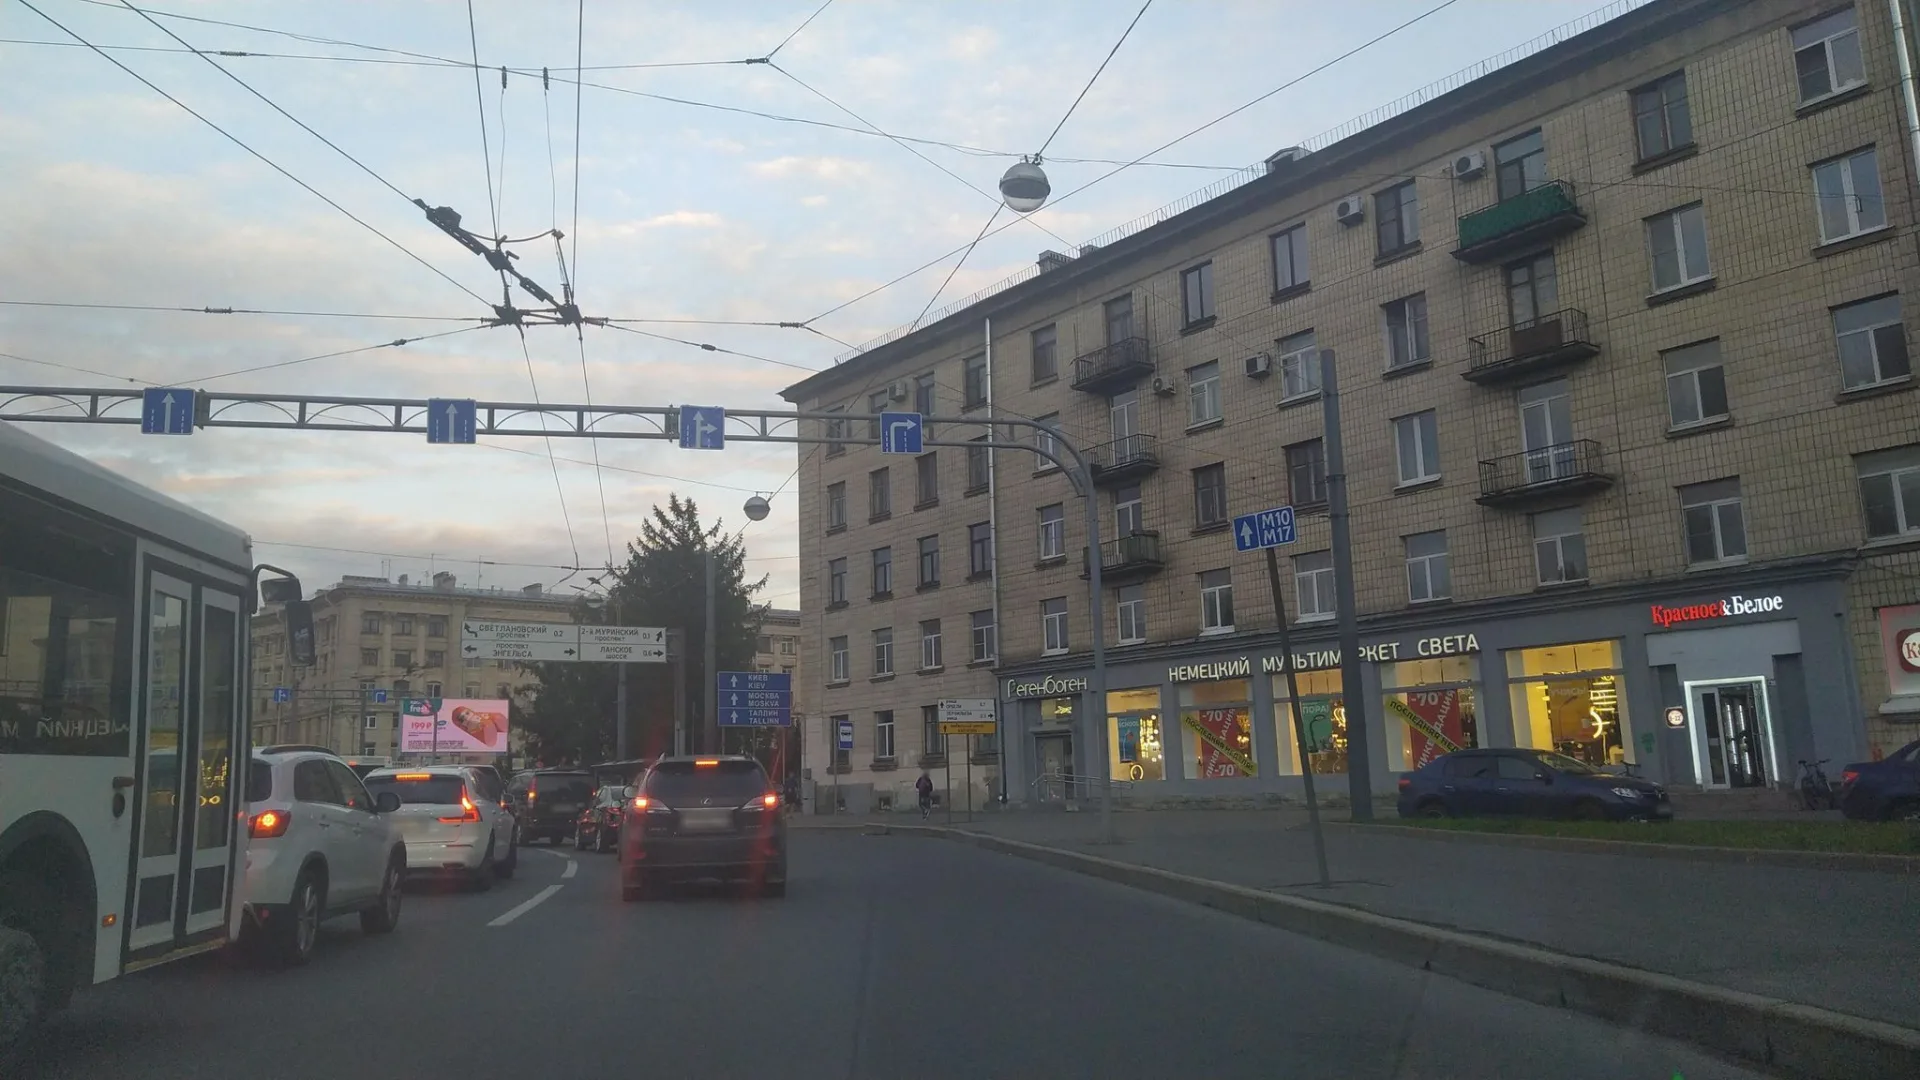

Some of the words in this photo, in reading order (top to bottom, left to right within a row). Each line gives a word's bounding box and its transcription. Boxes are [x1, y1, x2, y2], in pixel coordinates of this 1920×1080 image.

[1651, 595, 1783, 628] Красное&Белое
[479, 624, 547, 634] СВЕТЛАНОВСКИЙ
[595, 628, 639, 636] МУРИНСКИЙ
[493, 650, 533, 658] ЭНГЕЛЬСА
[1905, 642, 1920, 660] К
[1169, 656, 1250, 681] НЕМЕЦКИЙ
[1262, 642, 1400, 673] МУЬТИМРКЕТ
[1418, 633, 1480, 656] СВЕТА
[1007, 675, 1087, 698] Регенбоген
[748, 709, 779, 717] ТАЛЛИН
[748, 717, 780, 725] TALLINN
[411, 722, 425, 730] 199
